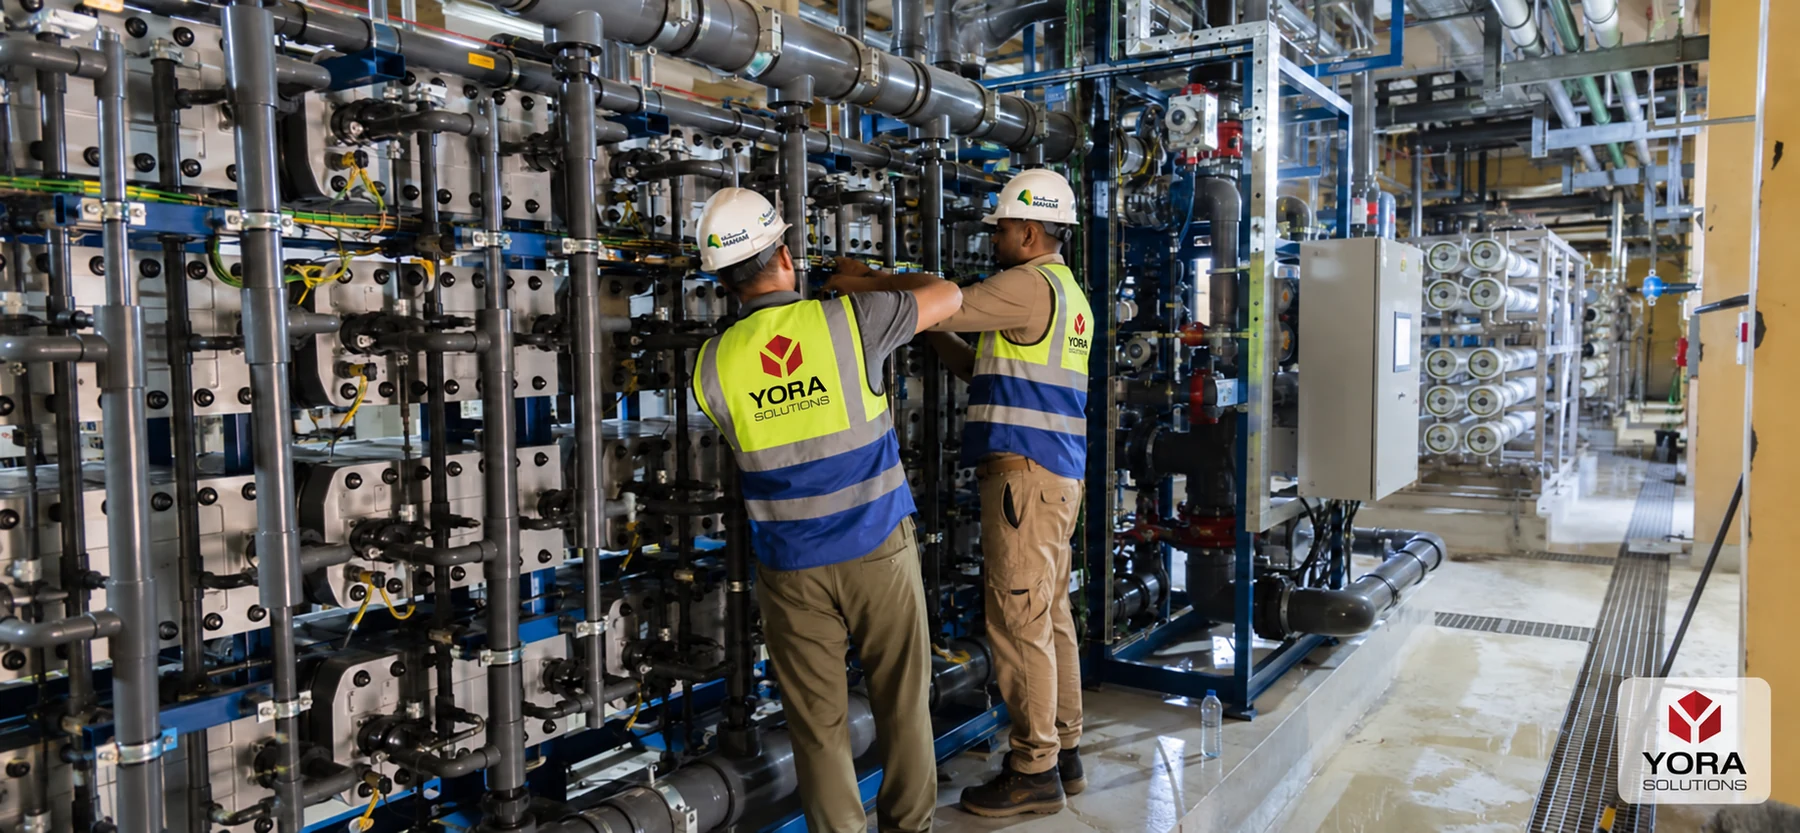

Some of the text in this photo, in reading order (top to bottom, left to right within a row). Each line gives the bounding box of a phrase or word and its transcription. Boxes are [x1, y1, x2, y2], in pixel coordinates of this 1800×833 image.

[1068, 336, 1088, 349] YORA
[748, 376, 827, 409] YORA
[754, 395, 830, 422] SOLUTIONS
